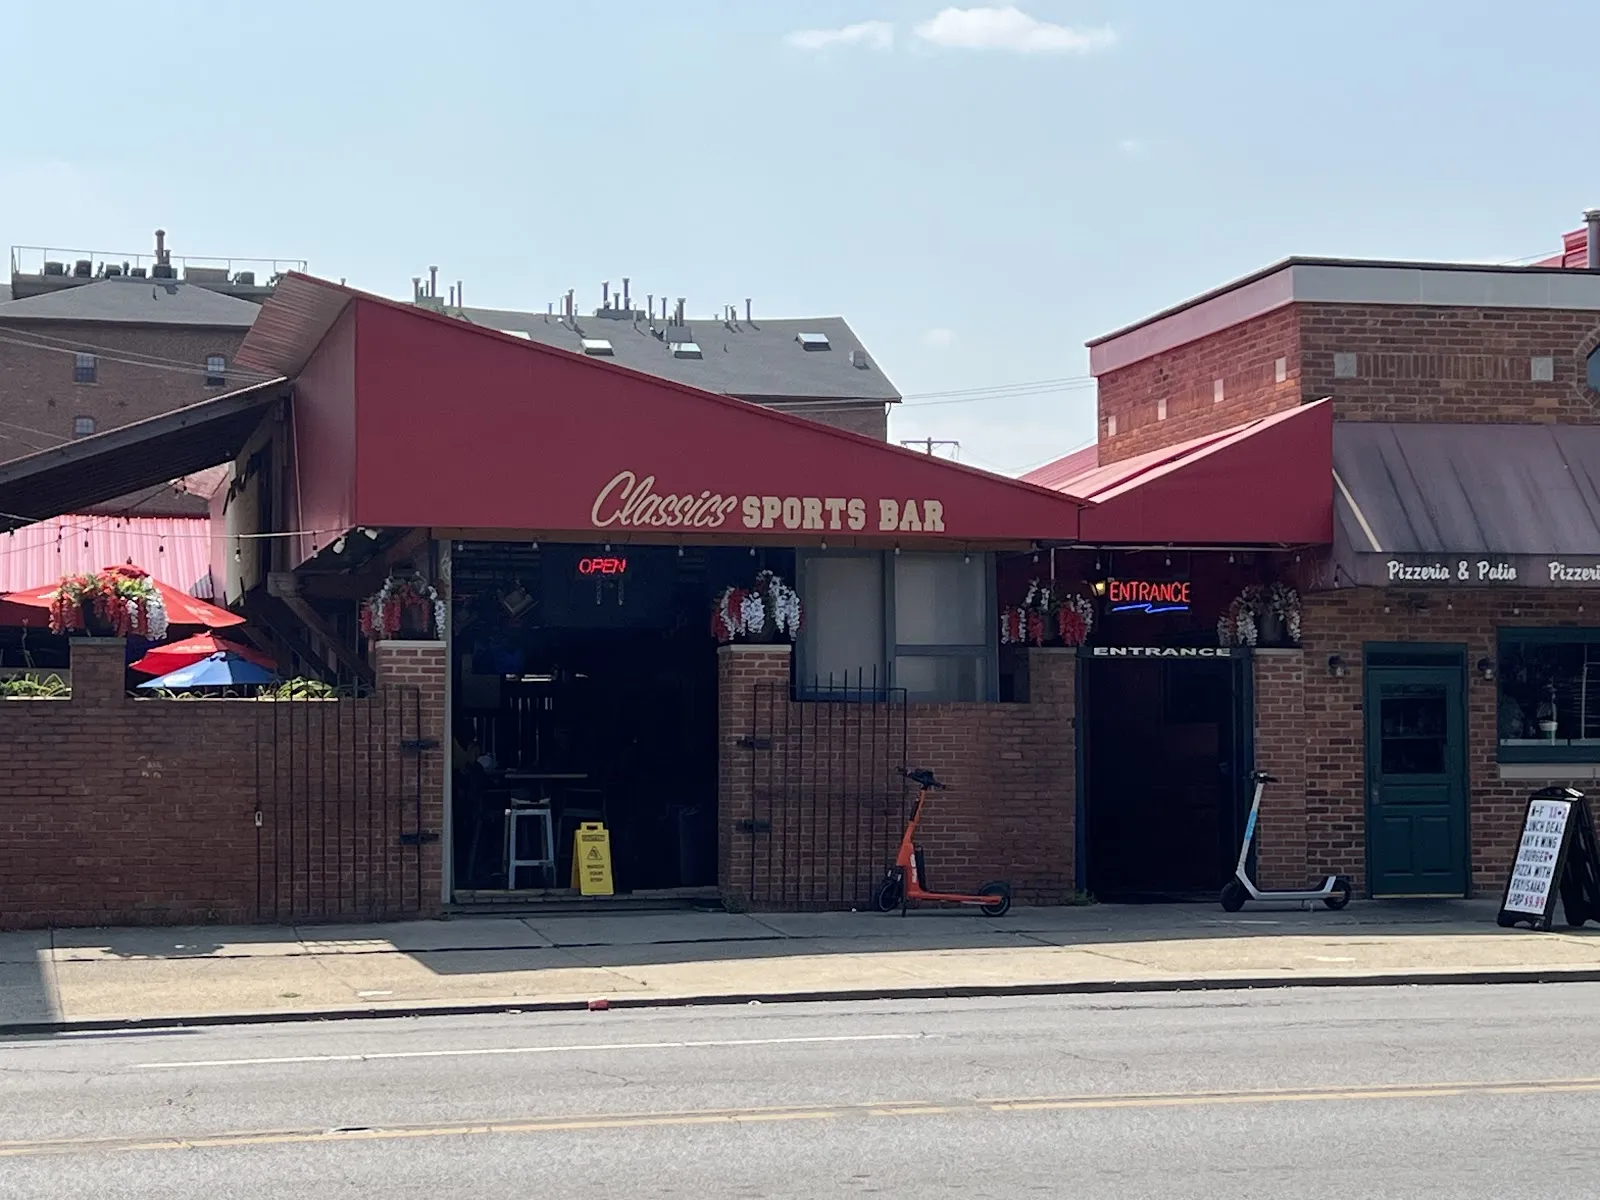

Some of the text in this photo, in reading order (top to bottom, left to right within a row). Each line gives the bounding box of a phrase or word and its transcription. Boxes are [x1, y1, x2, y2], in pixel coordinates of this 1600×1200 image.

[591, 470, 945, 532] Classics SPORTS BAR
[578, 557, 627, 574] OPEN
[1387, 560, 1517, 581] Pizzeria & Patio
[1109, 581, 1191, 603] ENTRANCE
[1093, 646, 1231, 657] ENTRANCE
[1545, 820, 1563, 834] DEAL
[1515, 864, 1552, 879] PIZZA WITH
